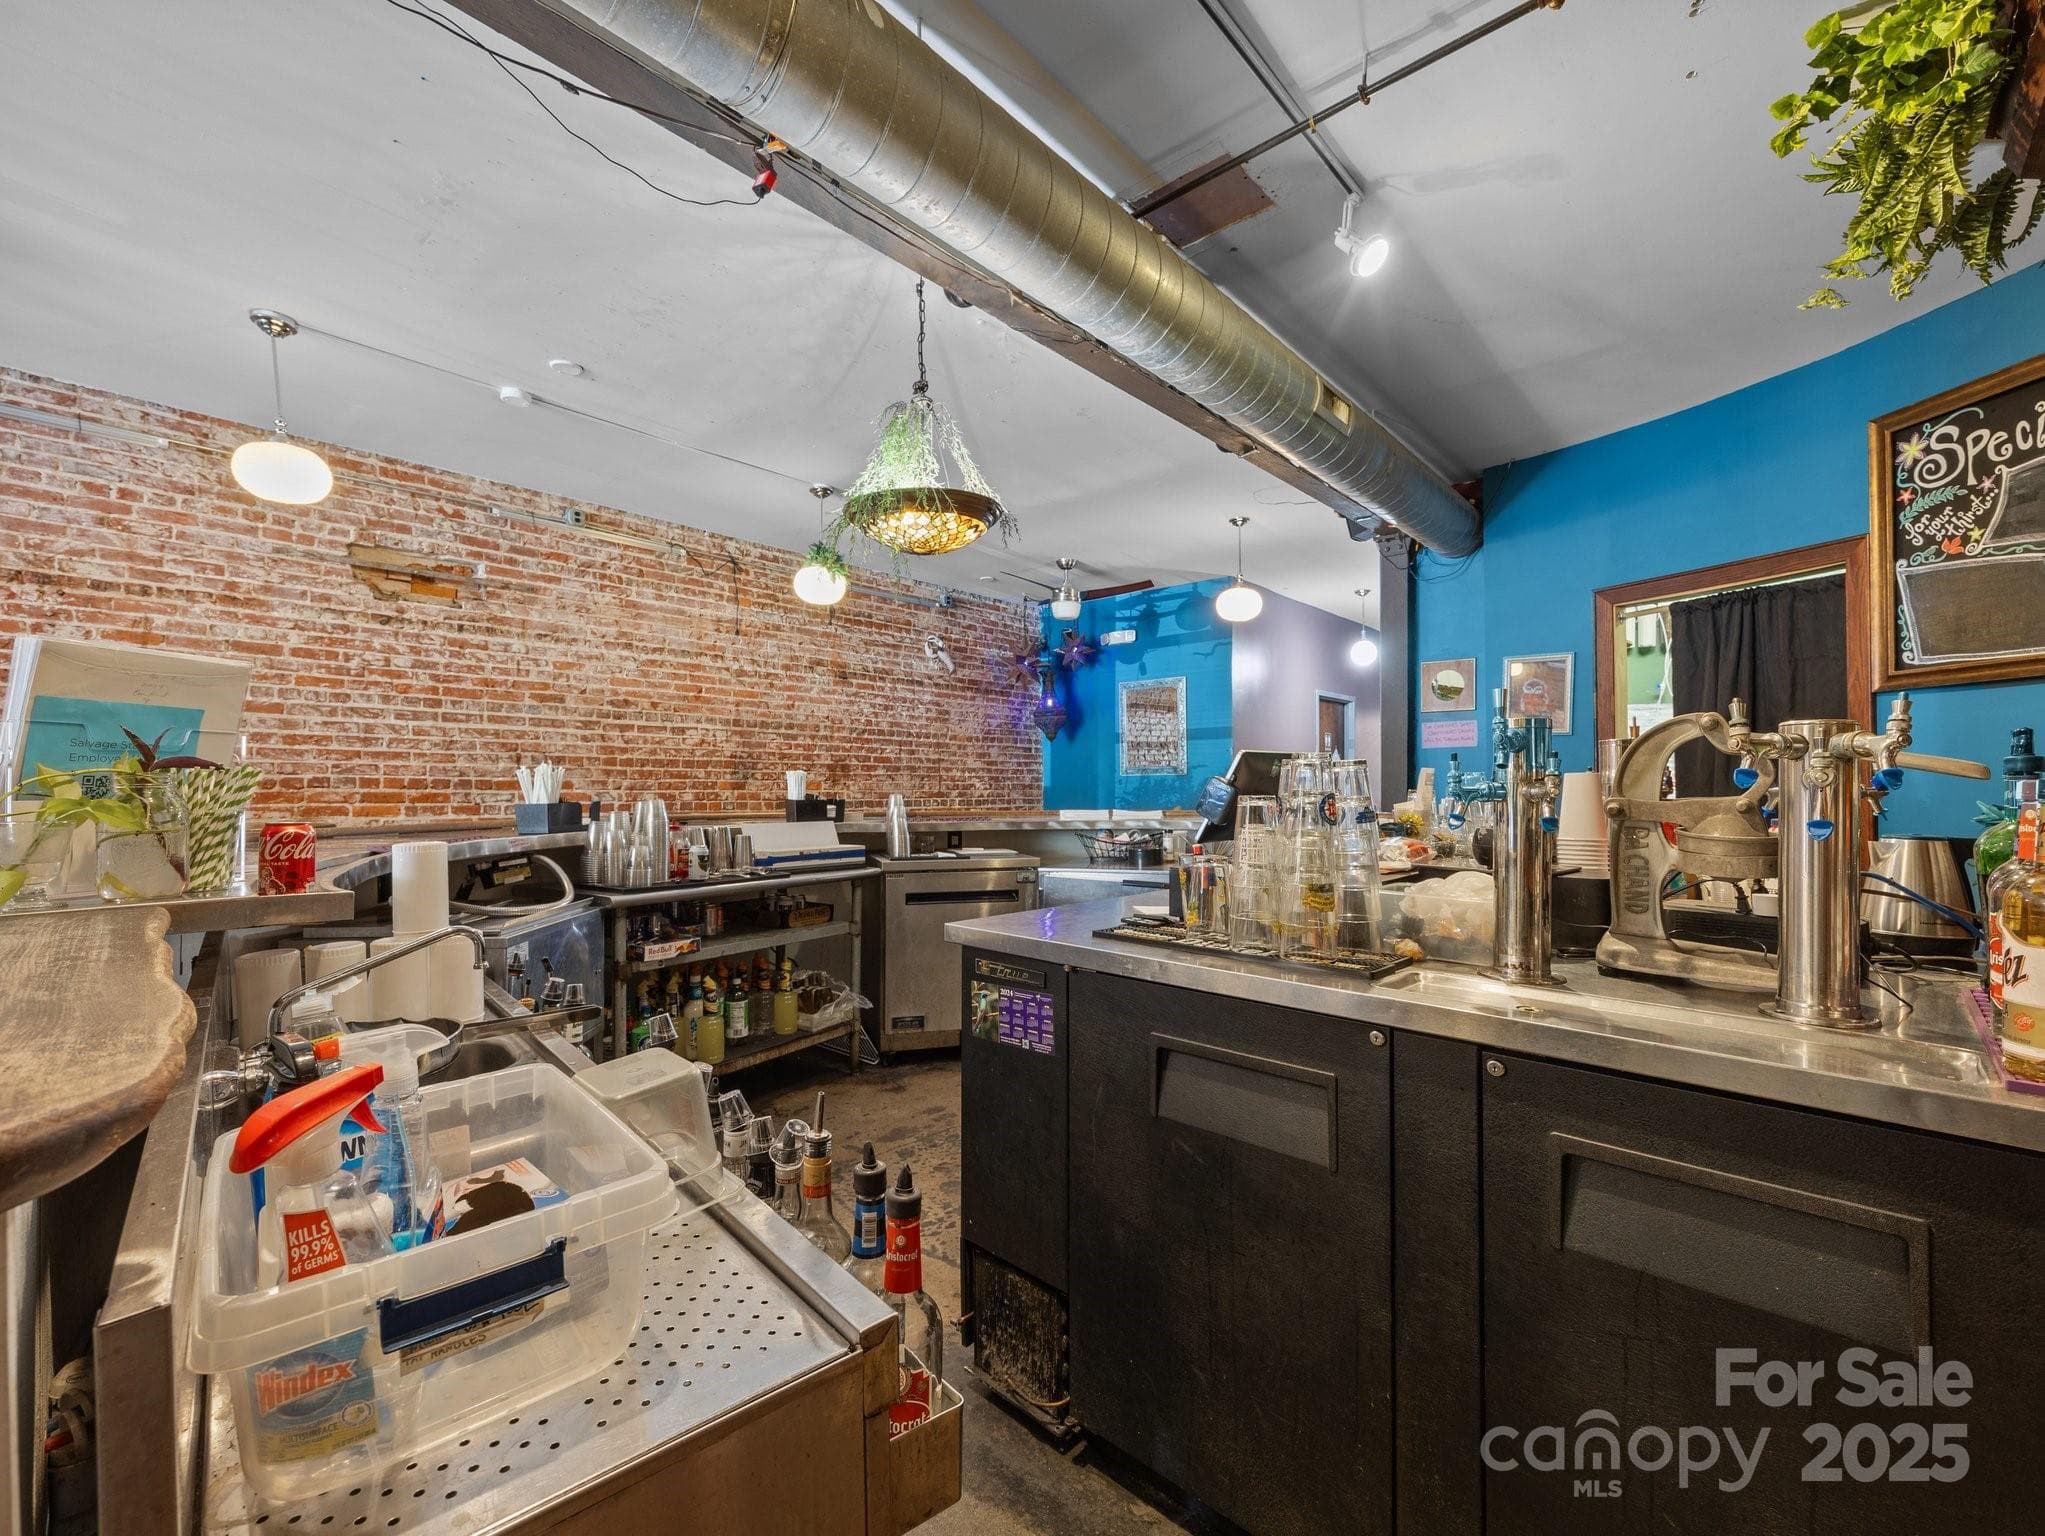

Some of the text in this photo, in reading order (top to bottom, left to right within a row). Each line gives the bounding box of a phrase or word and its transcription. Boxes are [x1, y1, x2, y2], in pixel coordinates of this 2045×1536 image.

[1905, 514, 1931, 546] for
[1924, 506, 1954, 542] your
[70, 738, 117, 750] Salvage
[264, 829, 315, 860] Cola
[288, 1220, 330, 1247] KILLS
[291, 1235, 334, 1263] 99.9%
[291, 1250, 339, 1275] of GERMS
[430, 1334, 487, 1359] HANDLES
[255, 1359, 358, 1418] Windex
